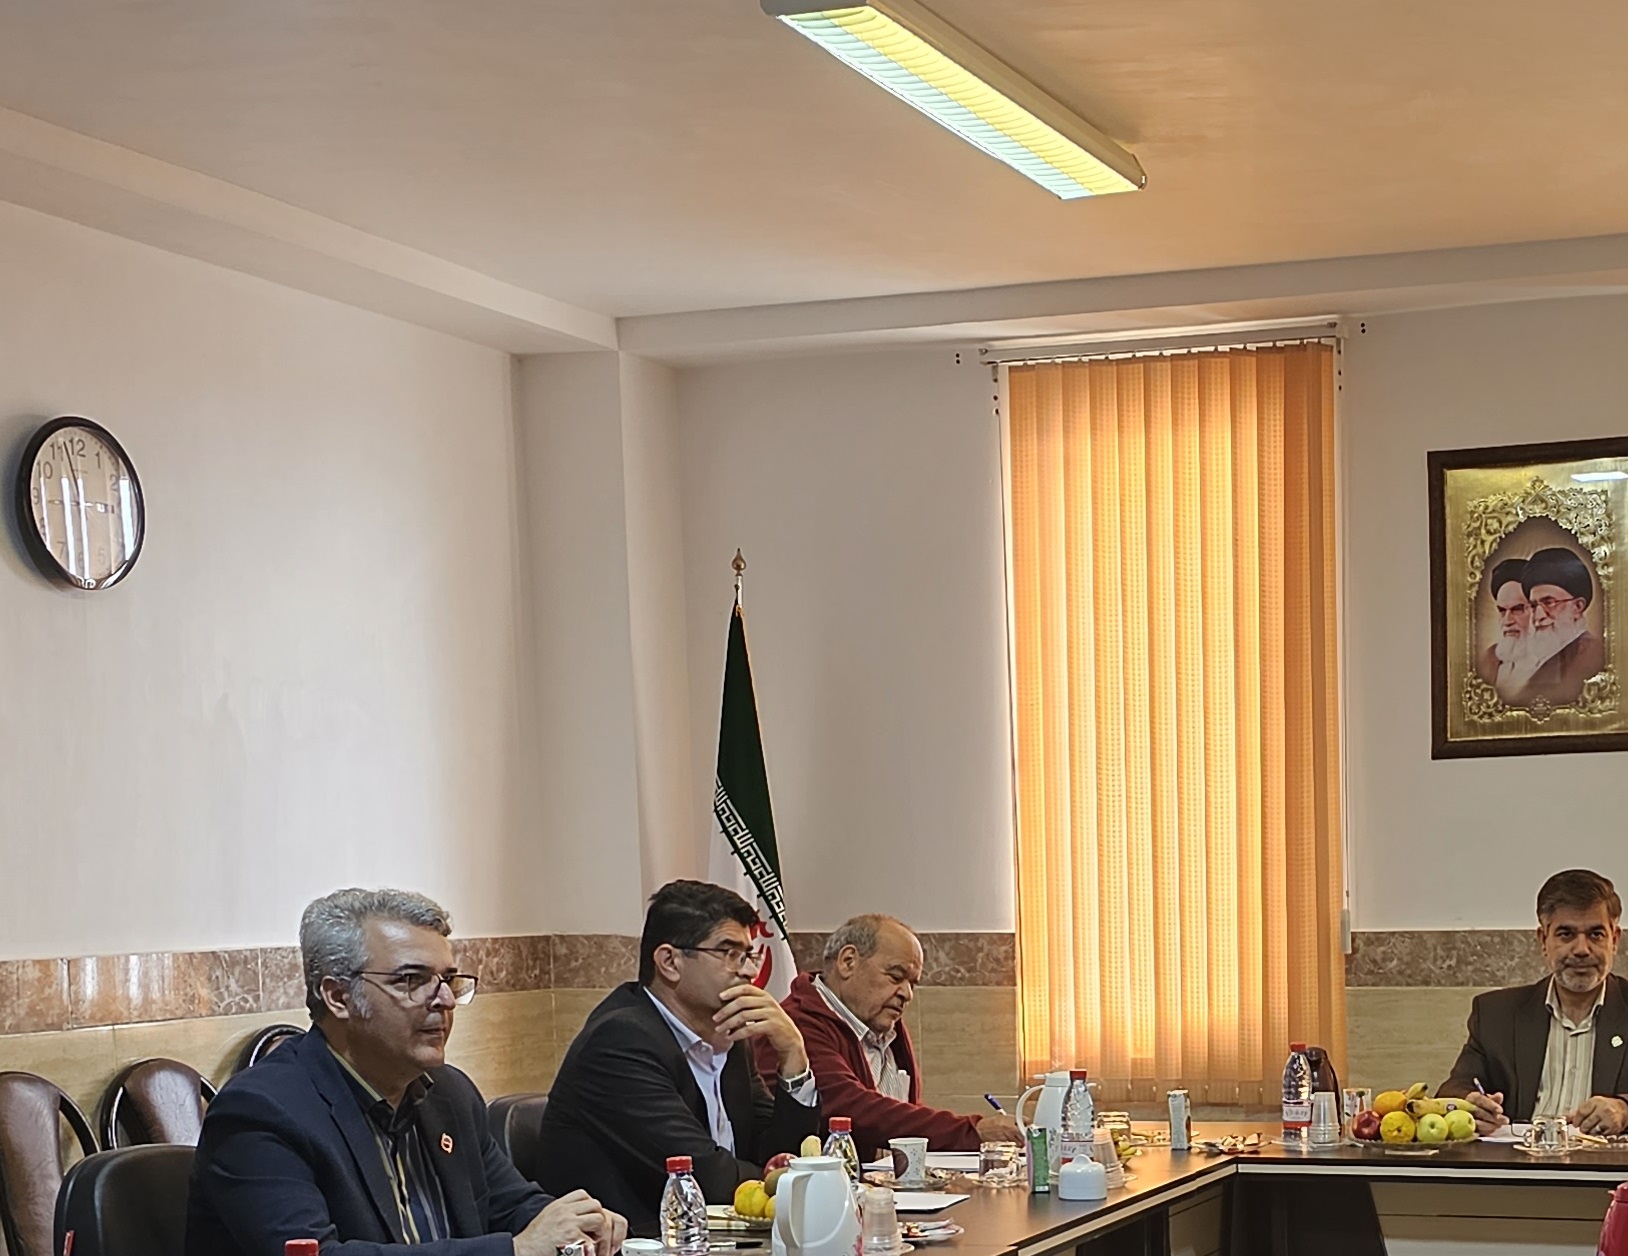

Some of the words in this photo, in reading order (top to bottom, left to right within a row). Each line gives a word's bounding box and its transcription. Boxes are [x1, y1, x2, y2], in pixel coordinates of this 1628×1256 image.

[69, 437, 86, 457] 12
[37, 460, 53, 479] 10
[95, 451, 102, 469] 1
[109, 474, 119, 491] 2
[56, 540, 66, 559] 7
